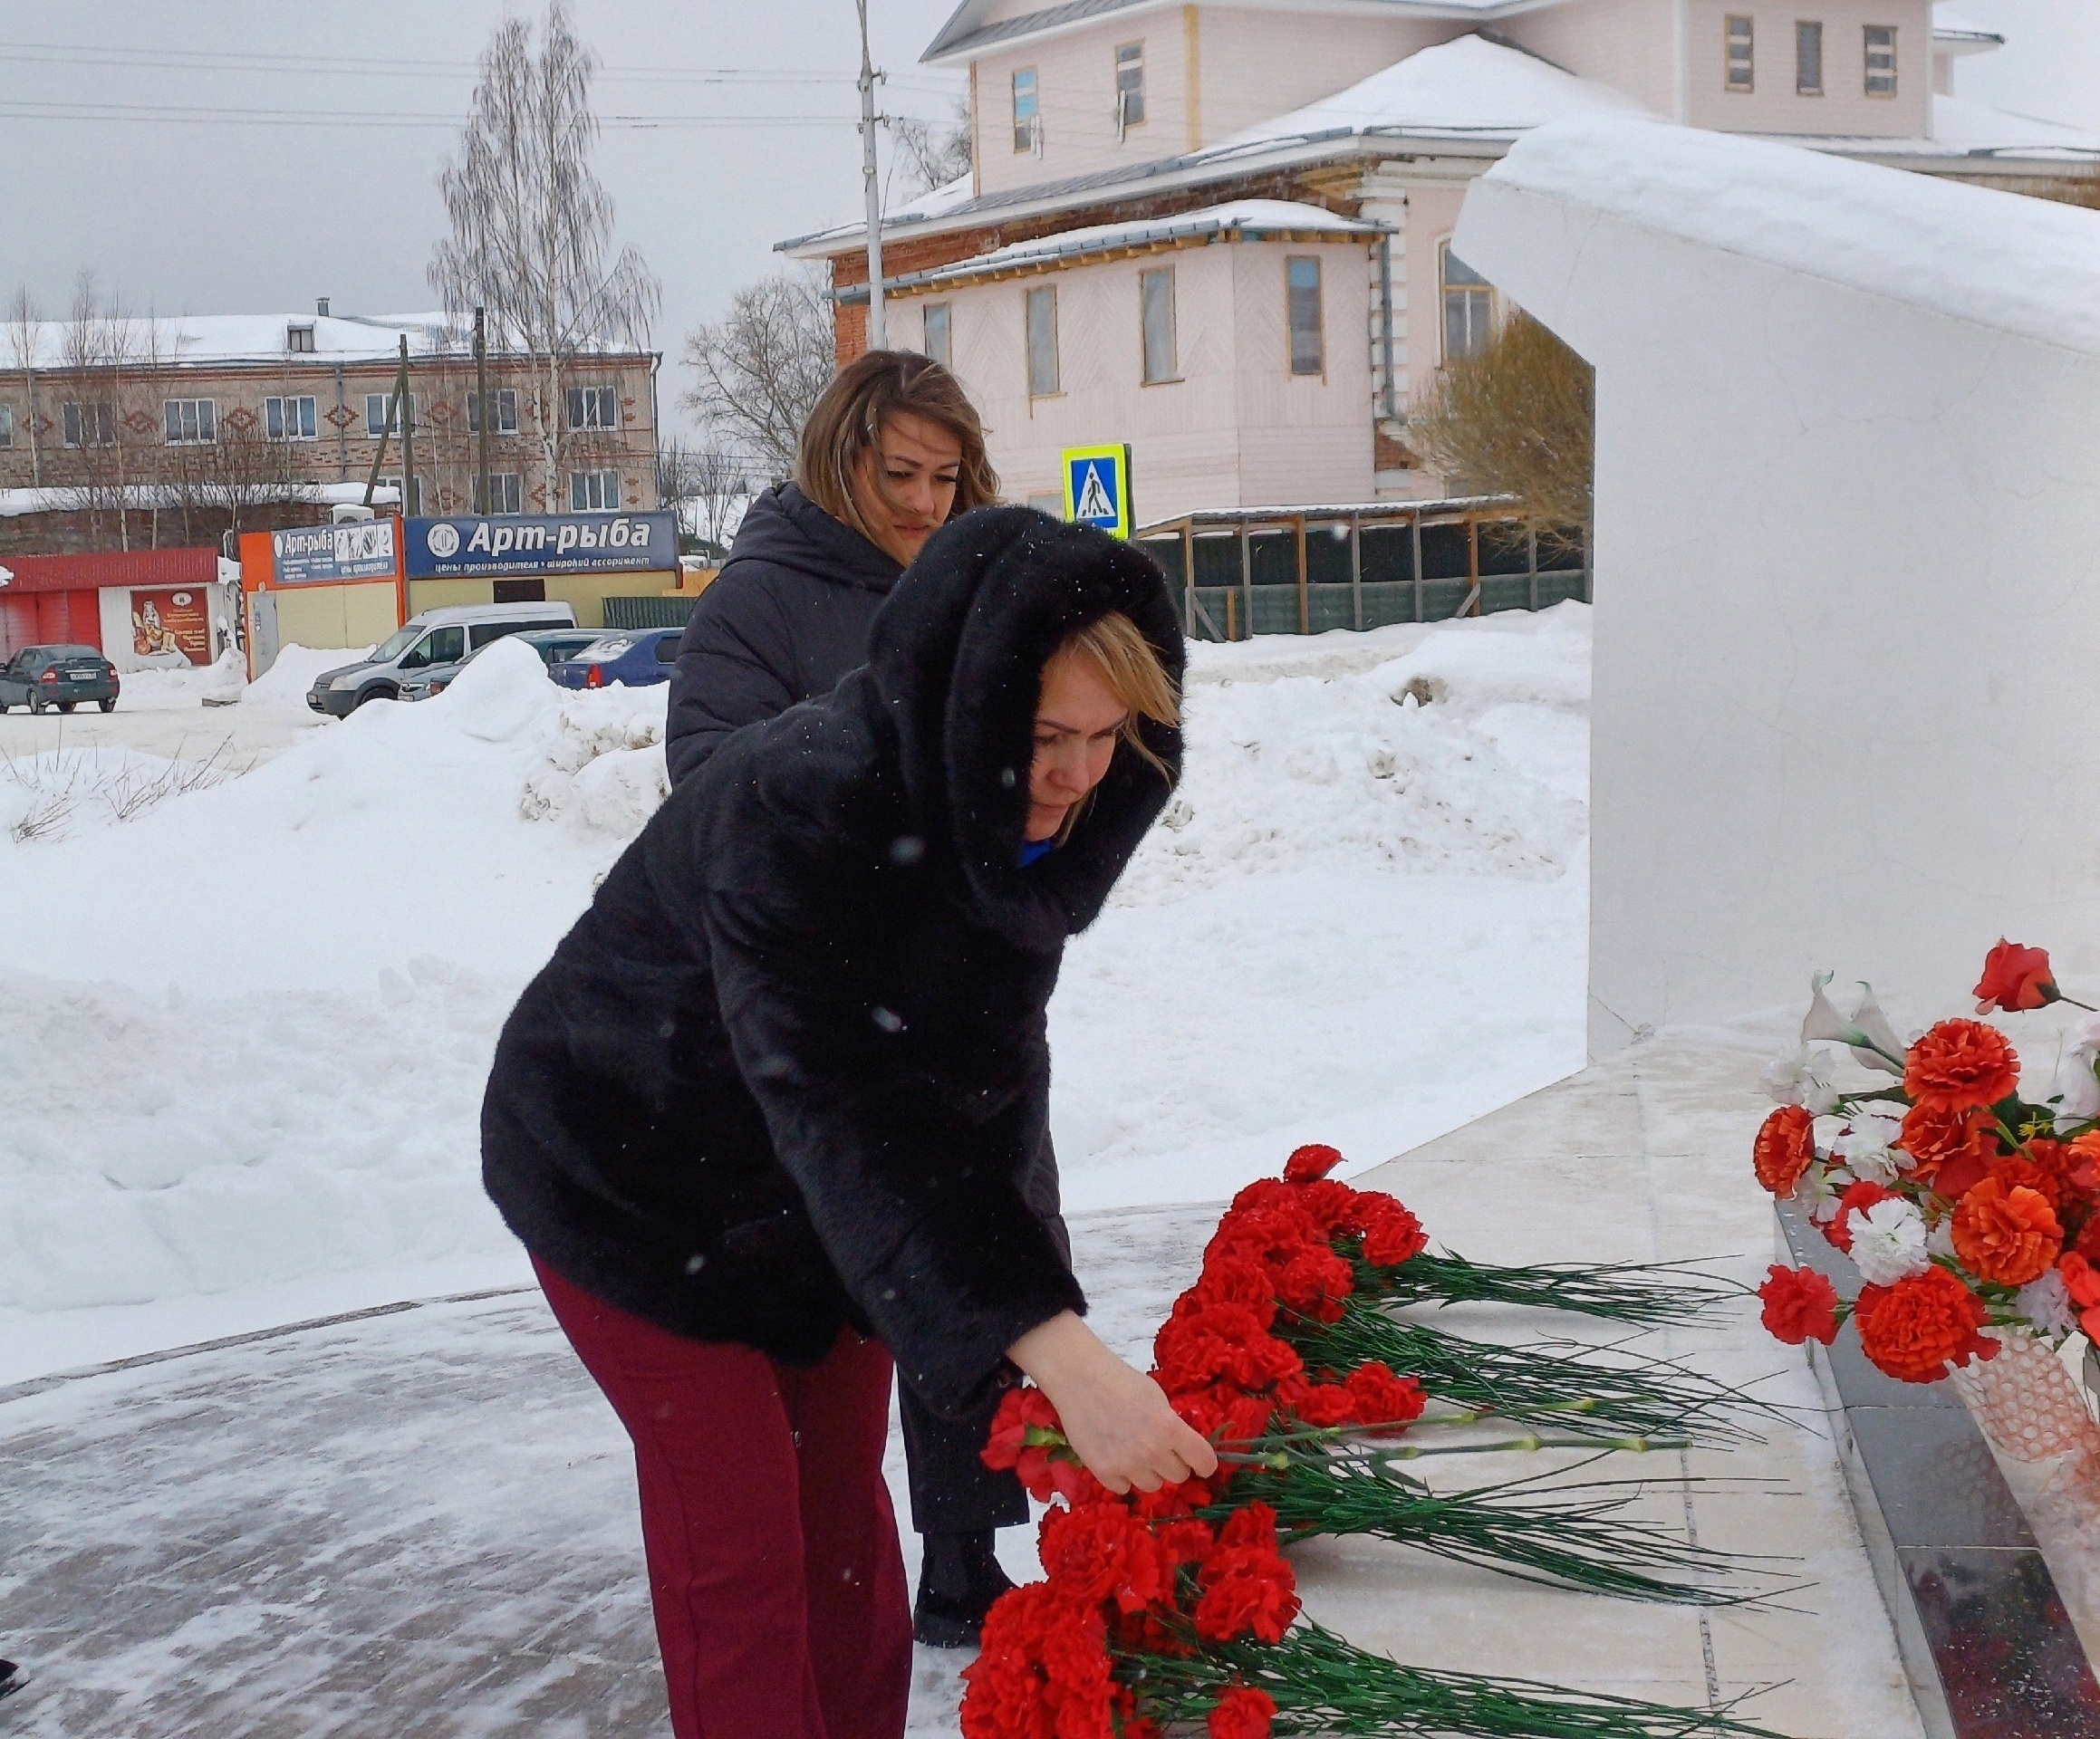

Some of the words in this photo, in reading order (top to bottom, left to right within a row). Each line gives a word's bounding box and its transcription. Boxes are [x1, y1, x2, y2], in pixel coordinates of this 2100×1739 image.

[284, 528, 333, 557] Арт-рыба
[467, 517, 650, 557] Арт-рыба
[435, 562, 461, 573] цены
